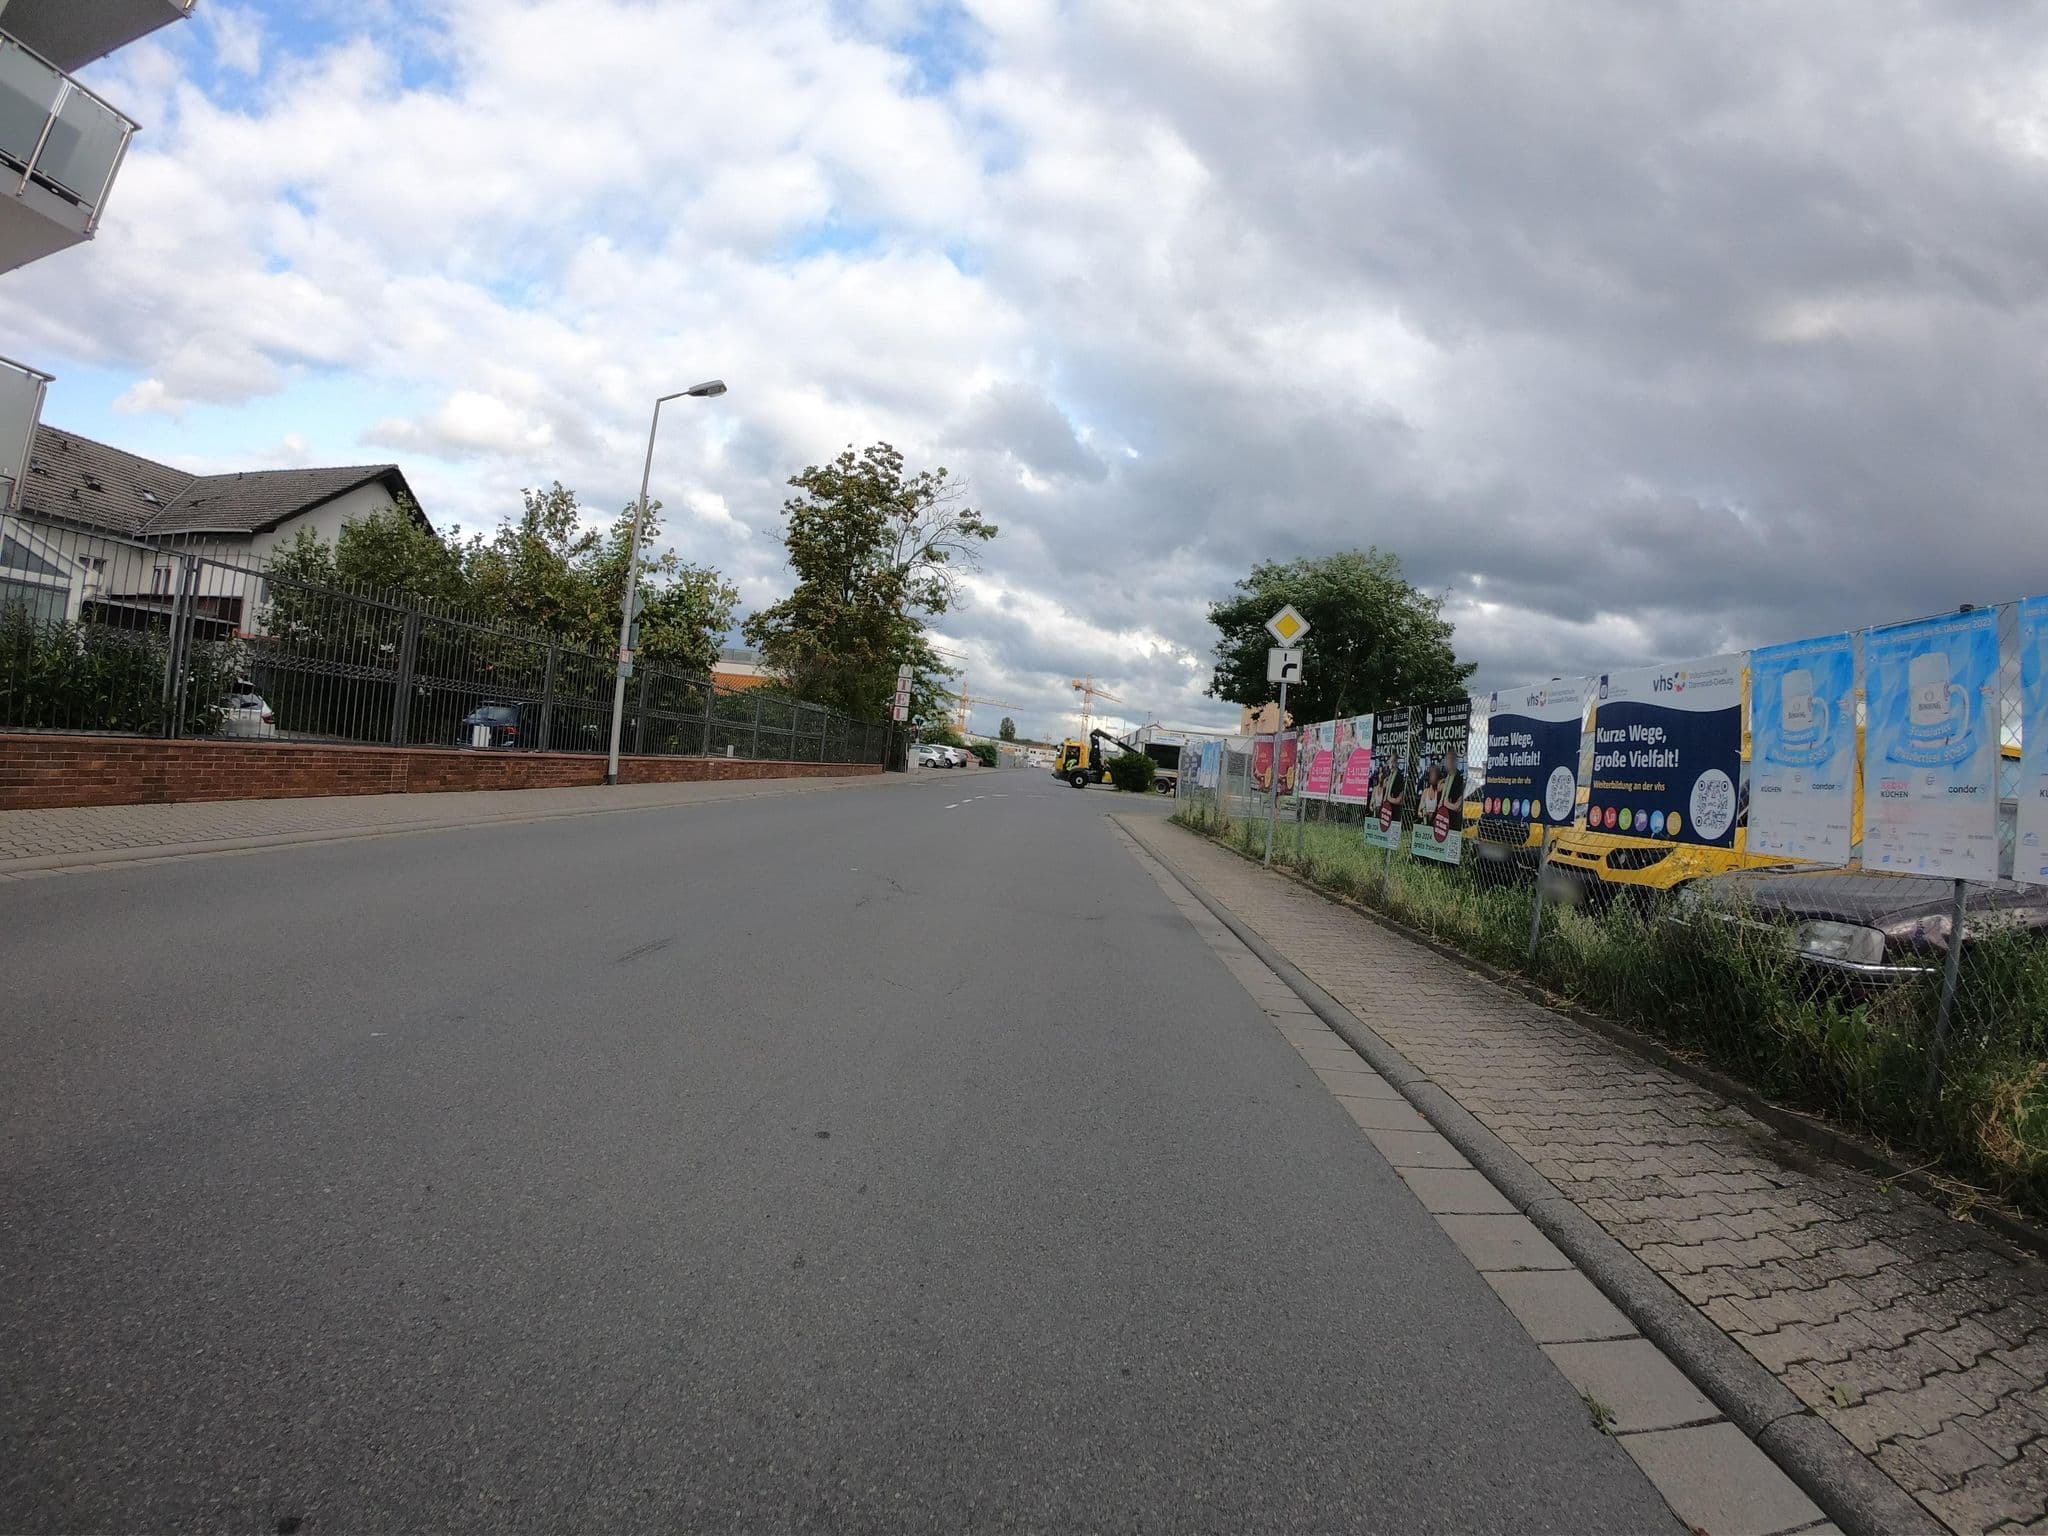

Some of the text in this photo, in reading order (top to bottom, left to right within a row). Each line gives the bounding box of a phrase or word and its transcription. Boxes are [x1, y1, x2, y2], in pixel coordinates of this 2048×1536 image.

[1653, 674, 1673, 692] vhs
[1527, 692, 1539, 707] vhs
[1376, 731, 1408, 744] WELCOME
[1426, 725, 1466, 741] WELCOME
[1488, 732, 1534, 748] Kurze Wege,
[1596, 724, 1667, 745] Kurze Wege,
[1488, 750, 1540, 769] große Vielfalt!
[1594, 748, 1679, 771] große Vielfalt!
[1593, 779, 1665, 792] Weiterbildung an der vhs
[1811, 783, 1835, 791] condor
[1948, 783, 1977, 794] condor
[1880, 789, 1909, 799] KÜCHEN
